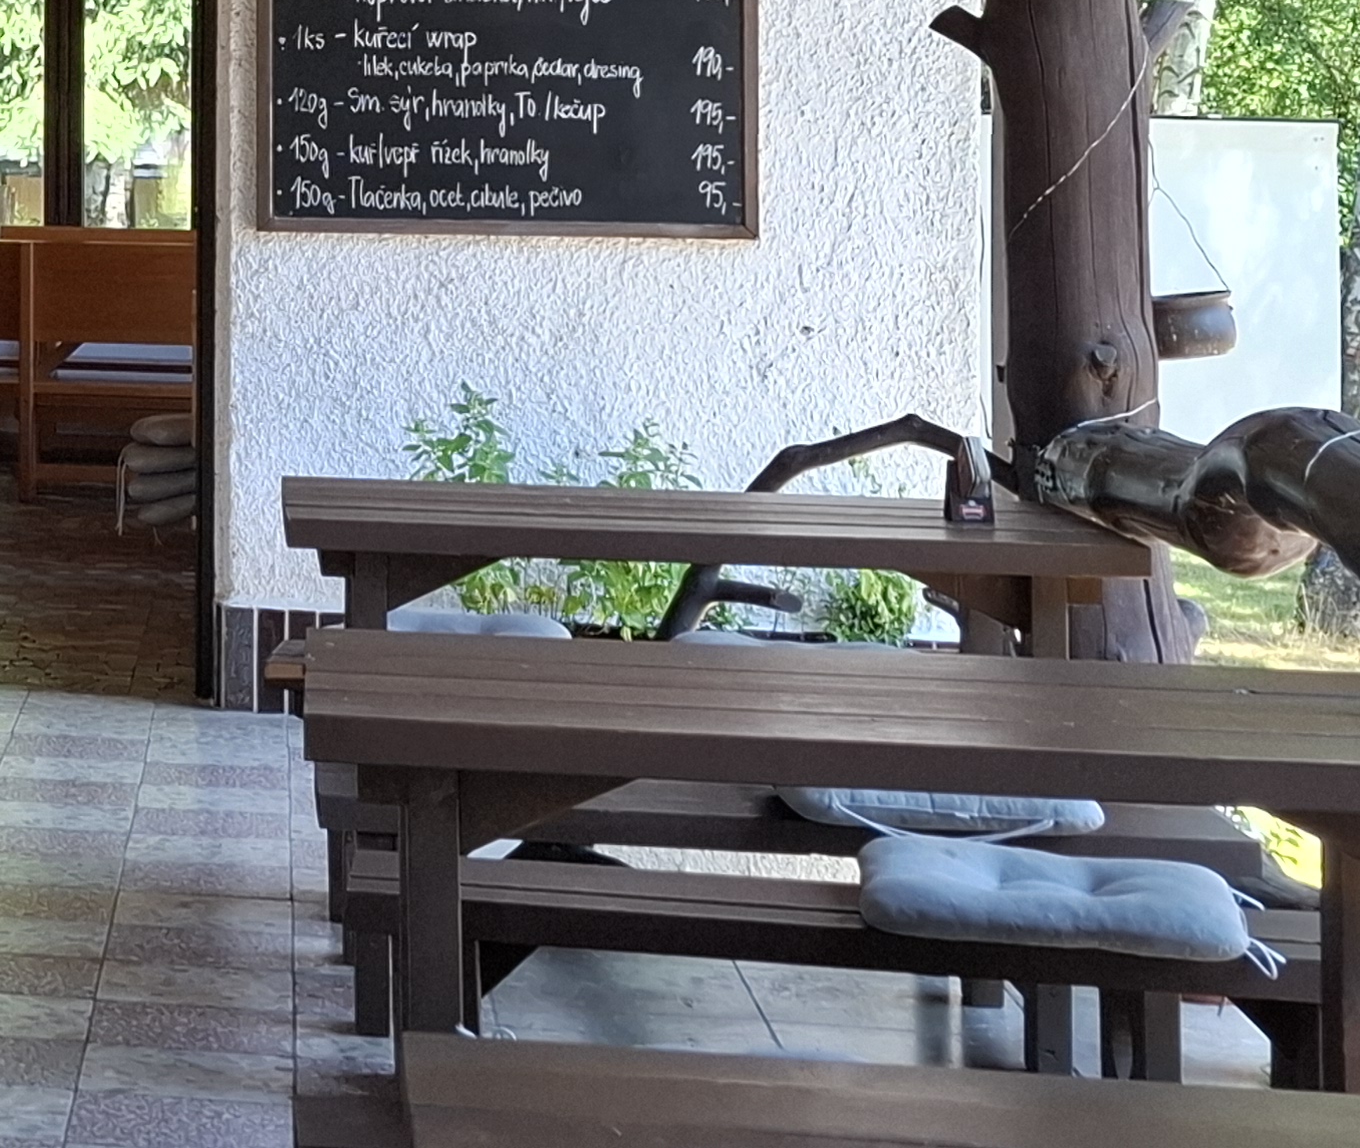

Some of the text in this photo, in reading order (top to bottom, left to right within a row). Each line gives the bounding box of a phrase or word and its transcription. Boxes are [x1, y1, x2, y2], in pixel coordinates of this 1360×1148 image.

[295, 20, 478, 61] 1ks kuřecí wrap
[288, 88, 328, 129] 120g
[289, 137, 330, 180] 150g
[528, 185, 583, 216] pečivo
